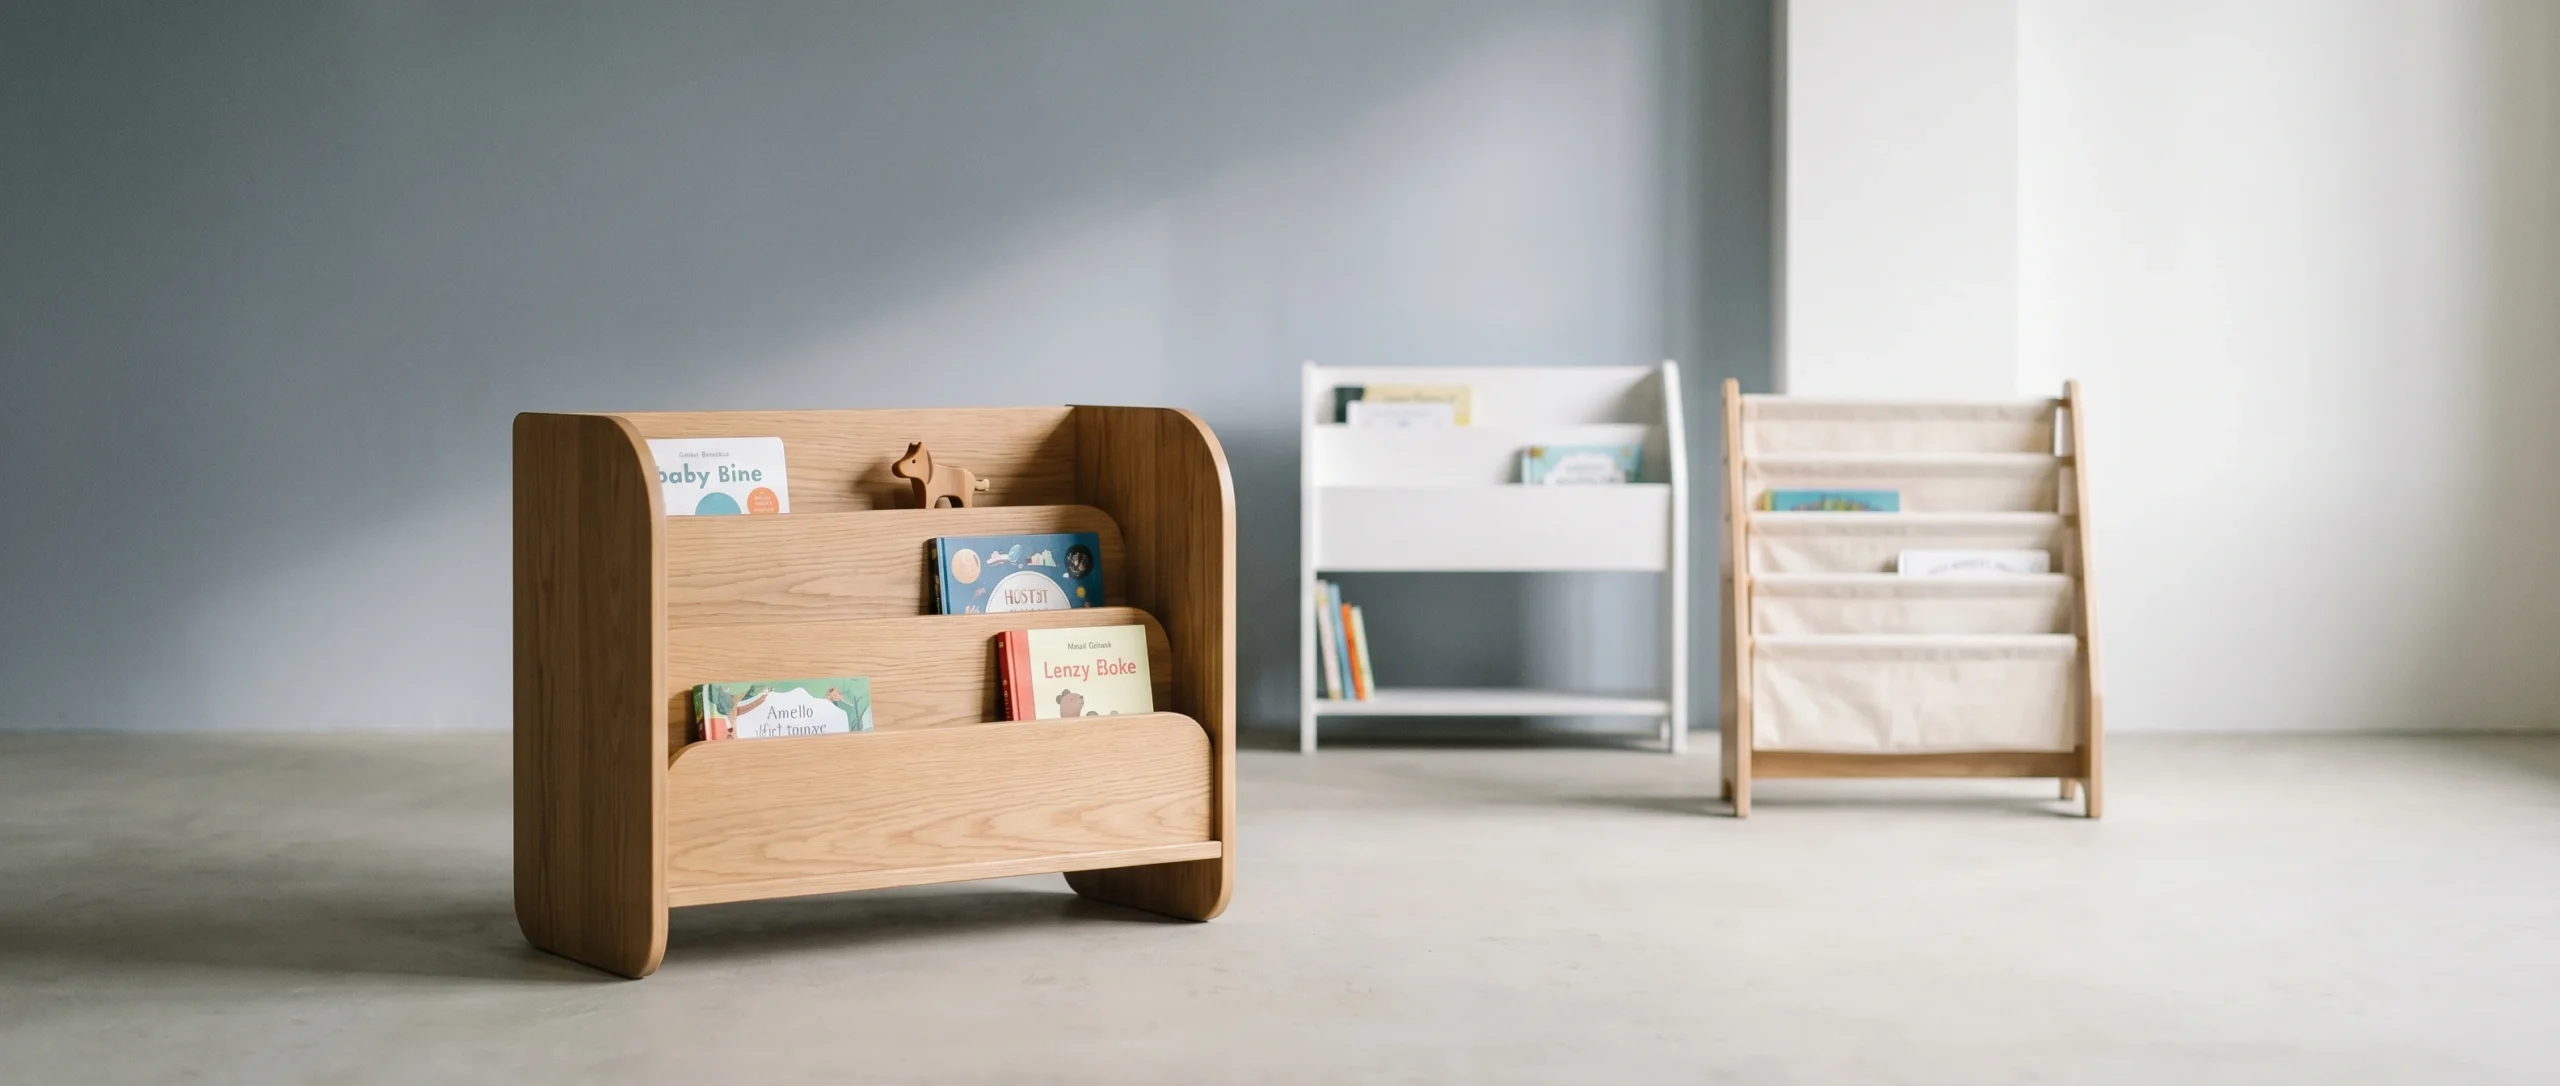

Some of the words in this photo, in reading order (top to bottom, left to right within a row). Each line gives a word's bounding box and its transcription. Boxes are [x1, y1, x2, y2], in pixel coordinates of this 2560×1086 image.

[656, 463, 710, 489] baby
[718, 463, 762, 483] Bine
[1044, 661, 1090, 682] Lenzy
[1096, 657, 1137, 677] Boke
[767, 704, 814, 720] Amello
